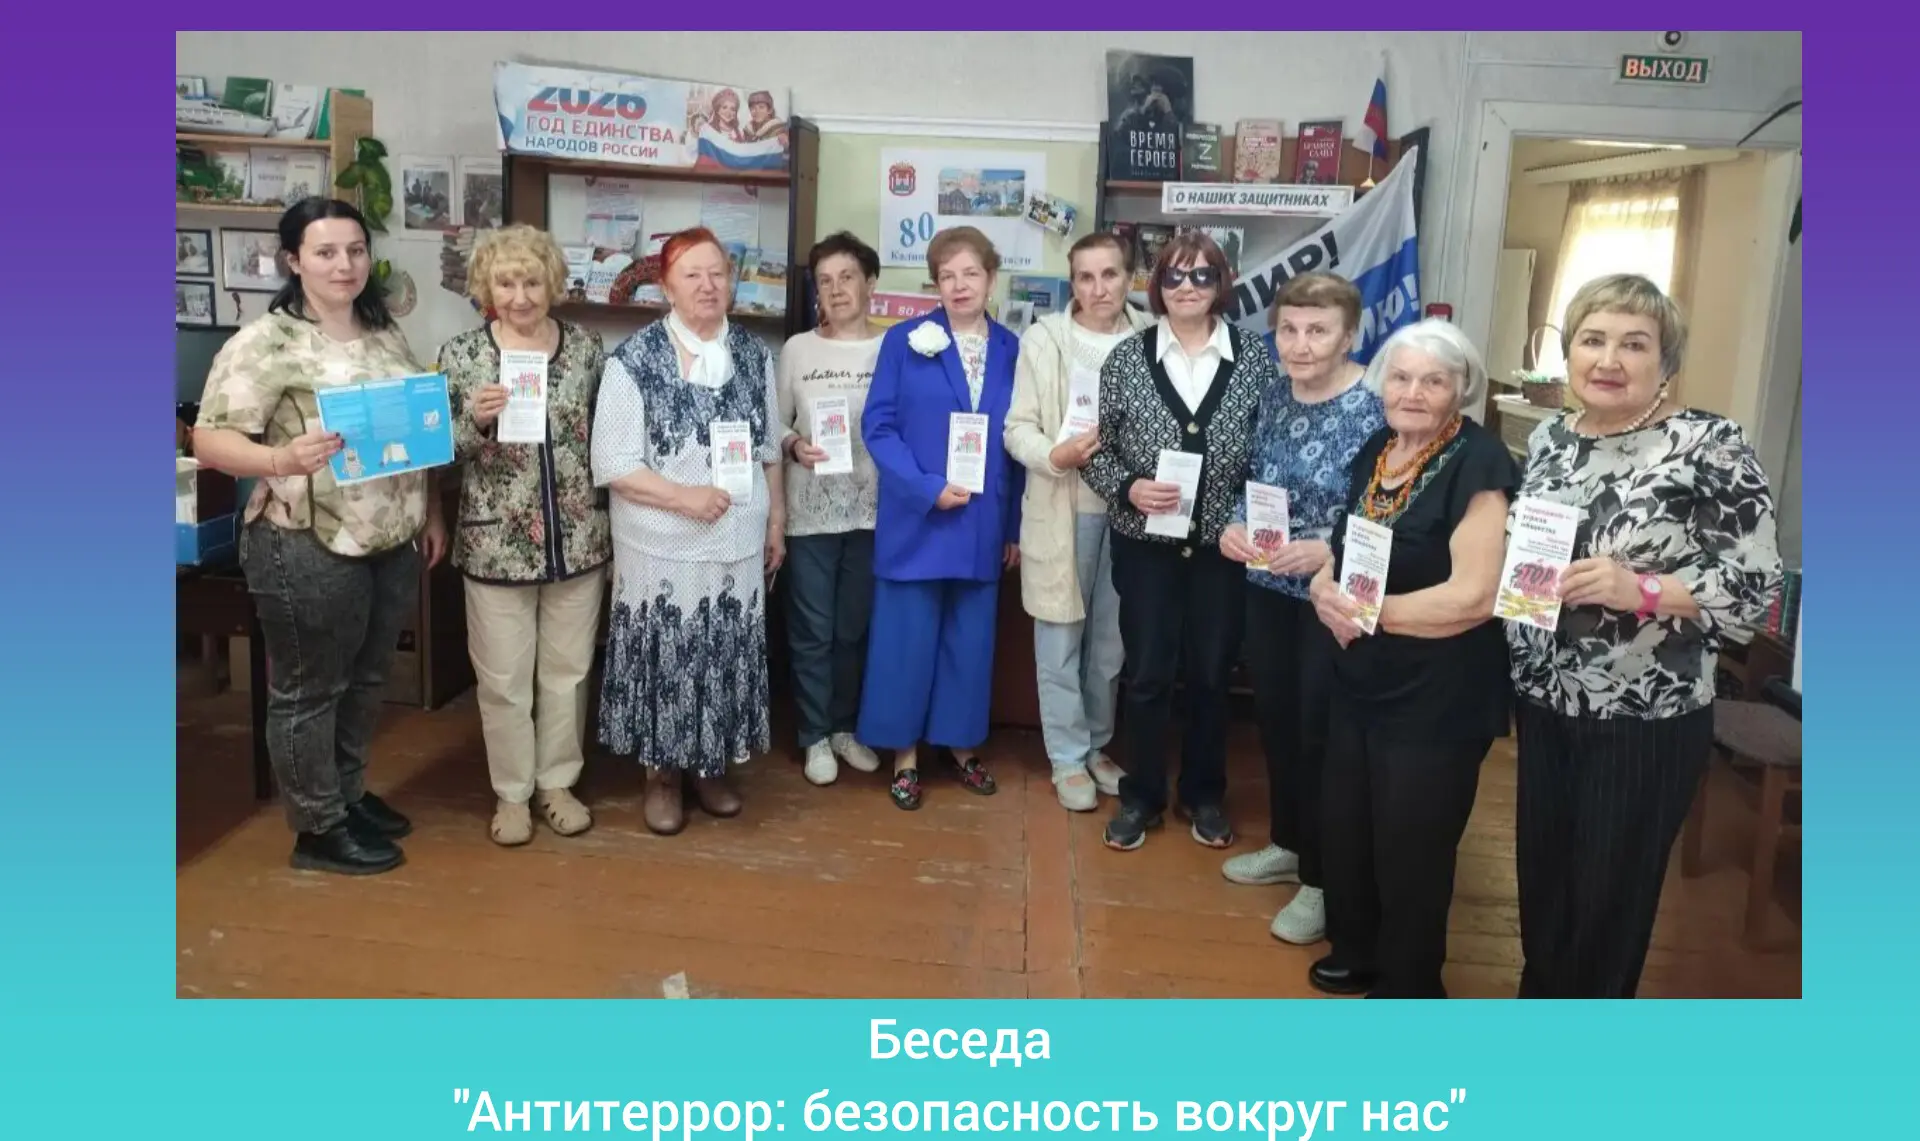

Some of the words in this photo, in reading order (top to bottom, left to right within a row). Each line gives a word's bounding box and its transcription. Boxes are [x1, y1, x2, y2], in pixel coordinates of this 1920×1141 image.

[1625, 58, 1703, 82] ВЫХОД
[526, 115, 565, 135] ГОД
[572, 119, 674, 144] ЕДИНСТВА
[1130, 130, 1176, 150] ВРЕМЯ
[525, 135, 598, 154] НАРОДОВ
[602, 142, 659, 159] РОССИИ
[1130, 149, 1177, 169] ГЕРОЕВ
[1175, 192, 1186, 204] О
[1188, 192, 1237, 205] НАШИХ
[1238, 192, 1331, 208] ЗАЩИТНИКАХ
[898, 211, 936, 248] 80
[801, 368, 852, 383] whatever
